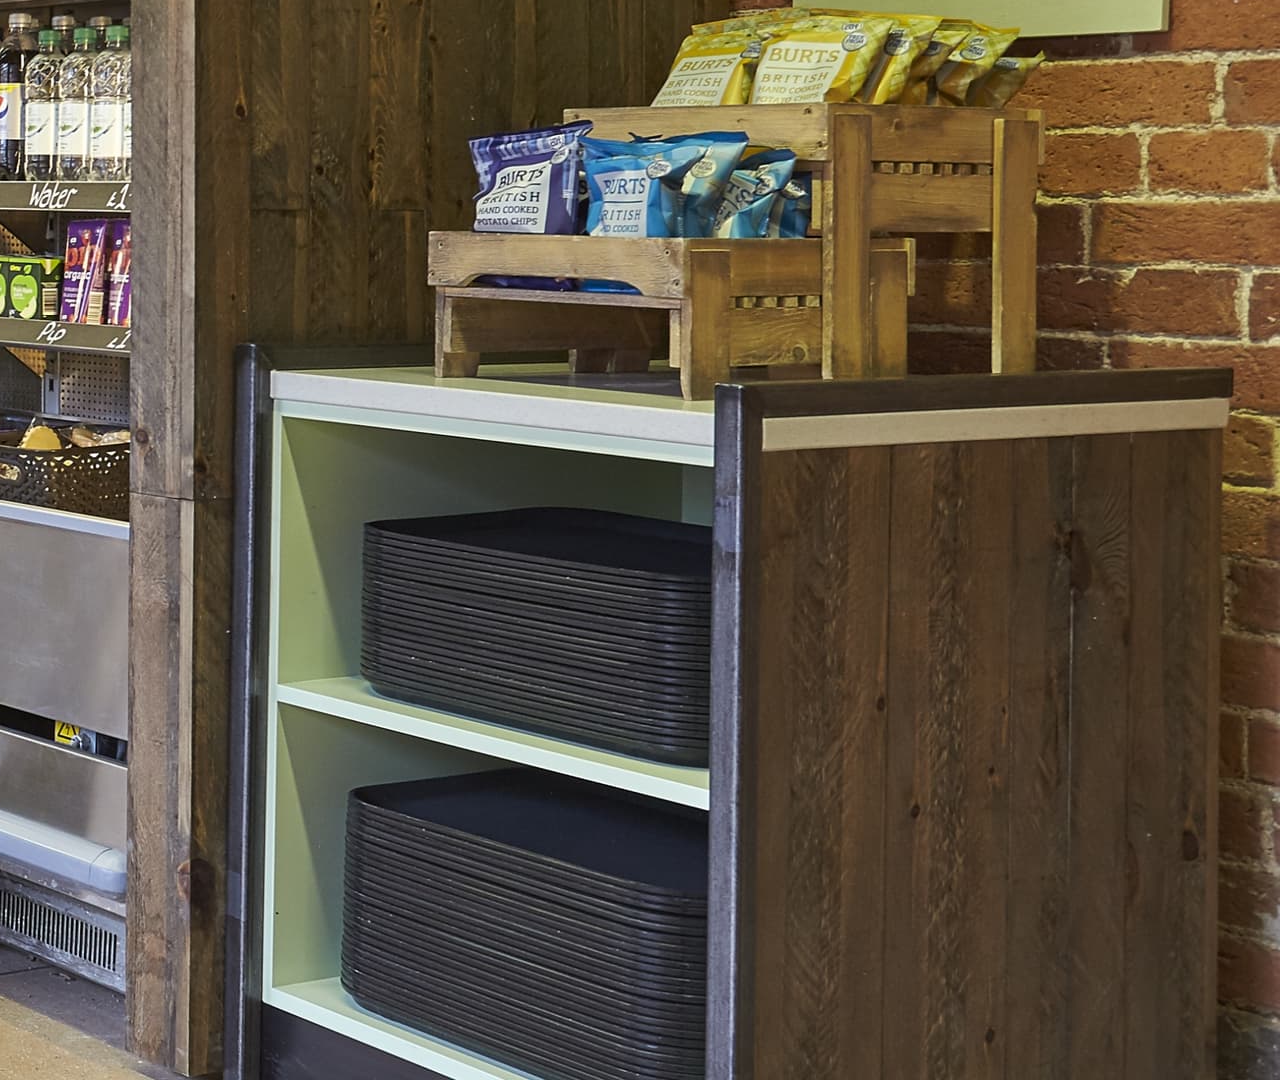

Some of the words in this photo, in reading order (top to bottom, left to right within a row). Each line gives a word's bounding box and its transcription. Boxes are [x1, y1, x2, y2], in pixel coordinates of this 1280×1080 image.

[768, 47, 840, 64] BURTS
[679, 57, 737, 72] BURTS
[666, 77, 723, 89] BRITISH
[761, 71, 829, 84] BRITISH
[498, 166, 547, 190] BURTS
[481, 191, 540, 205] BRITISH
[502, 205, 539, 214] COOKED
[602, 208, 642, 220] RITISH
[36, 322, 67, 344] Pip
